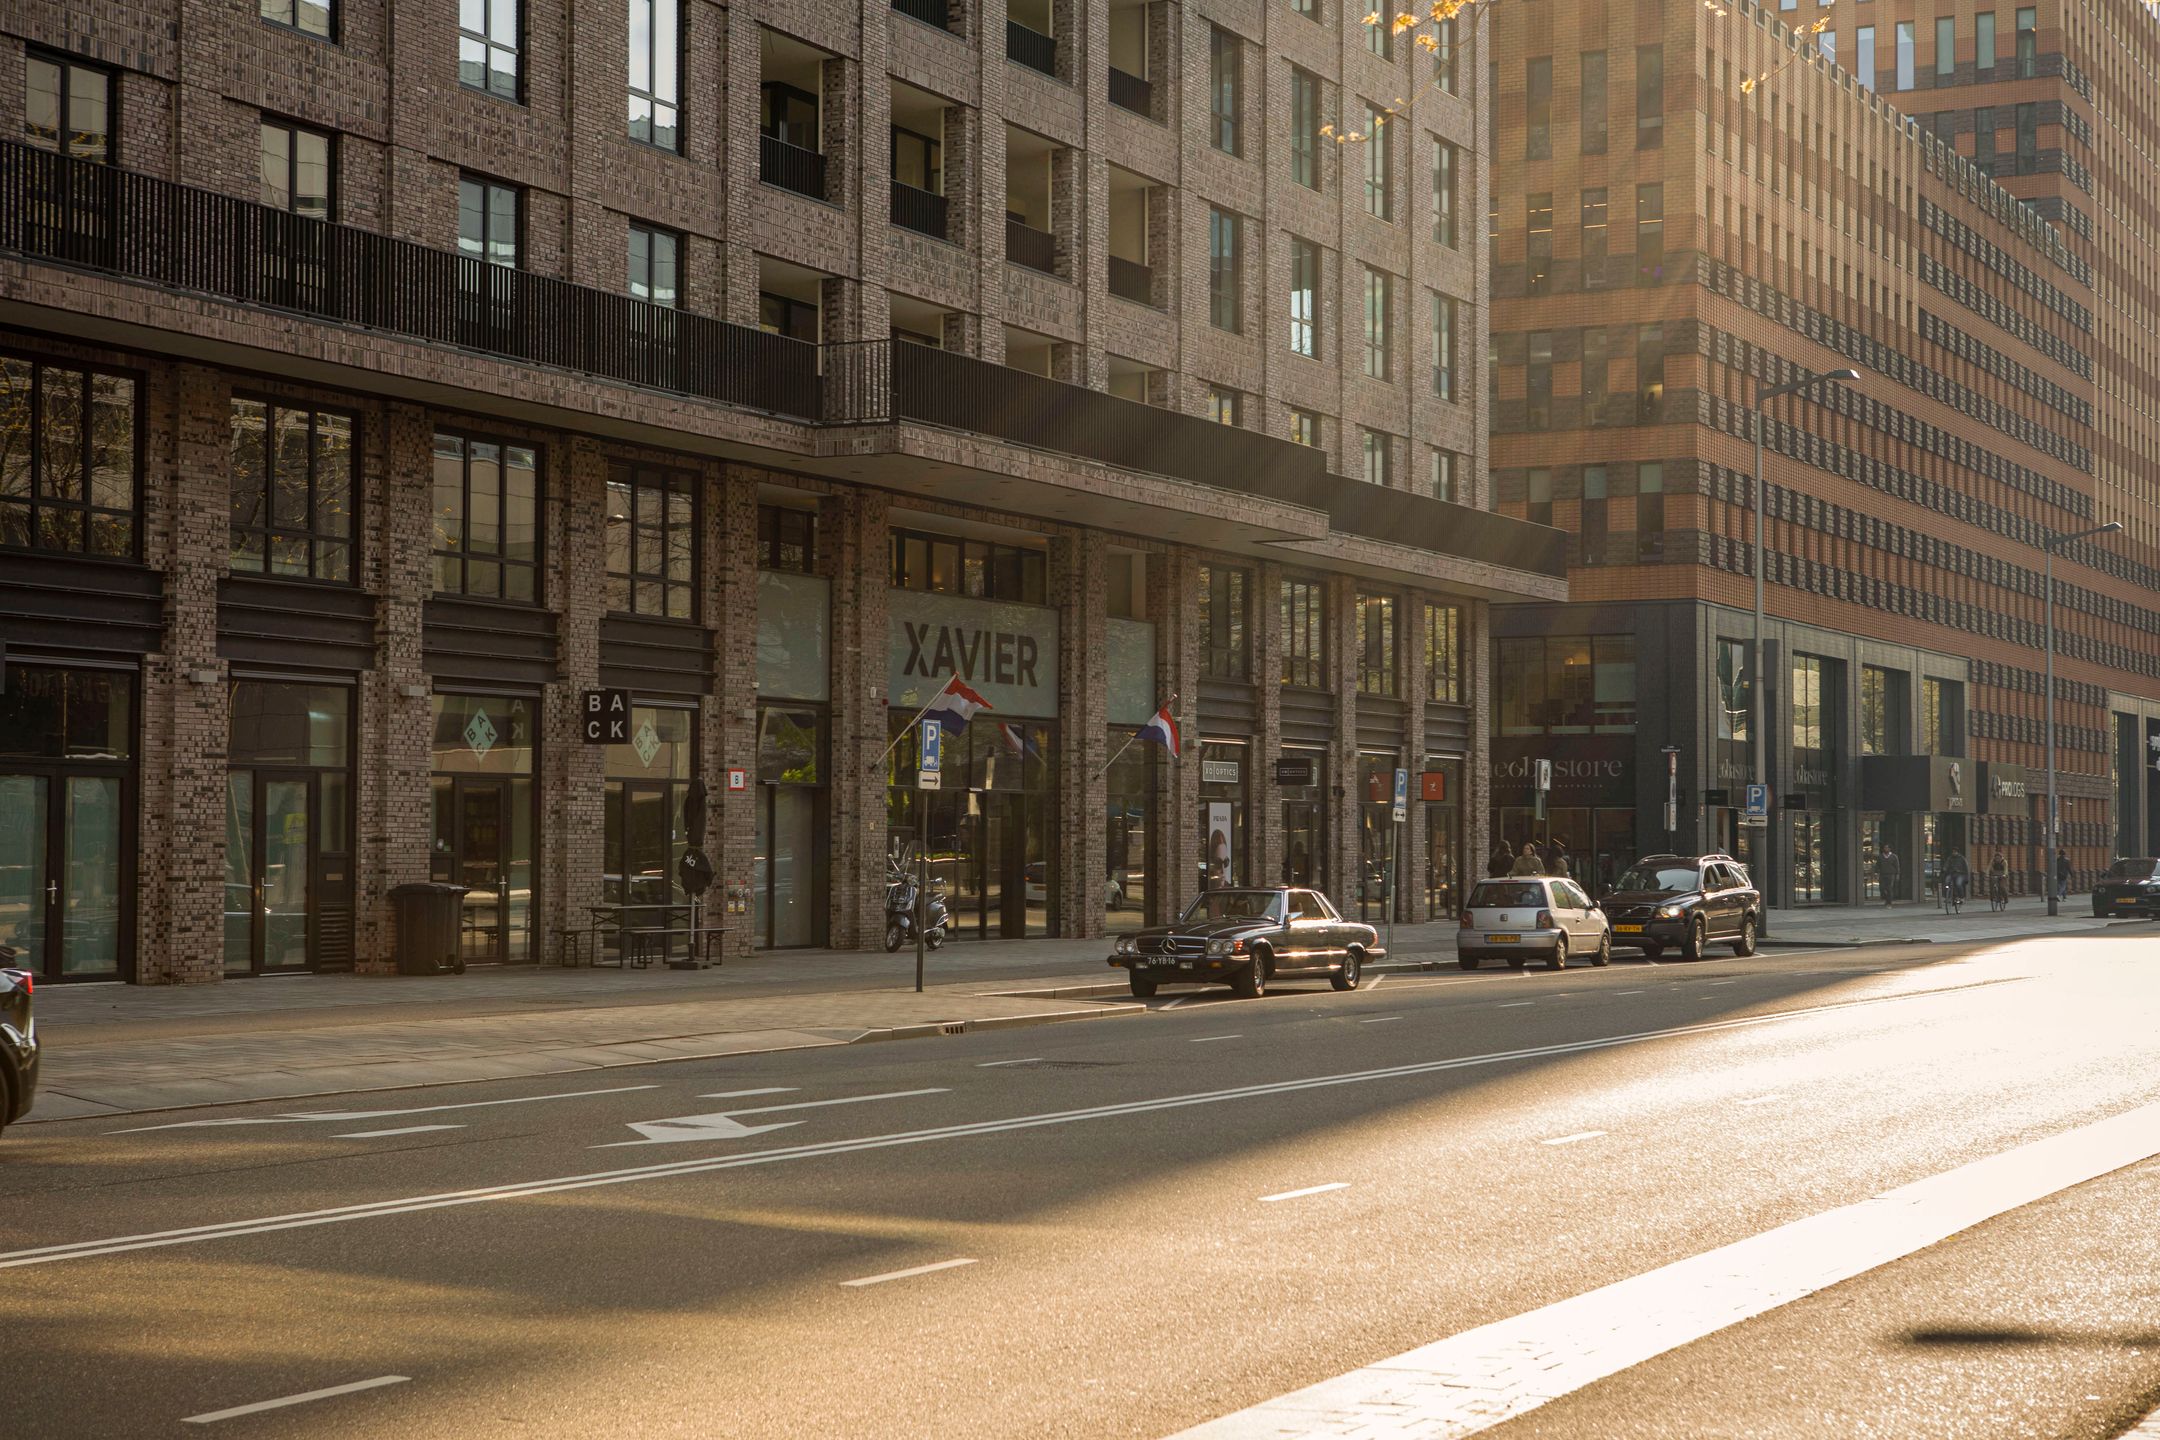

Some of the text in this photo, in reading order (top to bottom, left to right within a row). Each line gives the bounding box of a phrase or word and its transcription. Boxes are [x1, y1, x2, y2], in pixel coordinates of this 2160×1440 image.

[902, 621, 1038, 687] XAVIER
[926, 724, 937, 751] P
[1215, 768, 1236, 777] OPTICS
[1397, 772, 1405, 792] P
[1751, 787, 1763, 803] P
